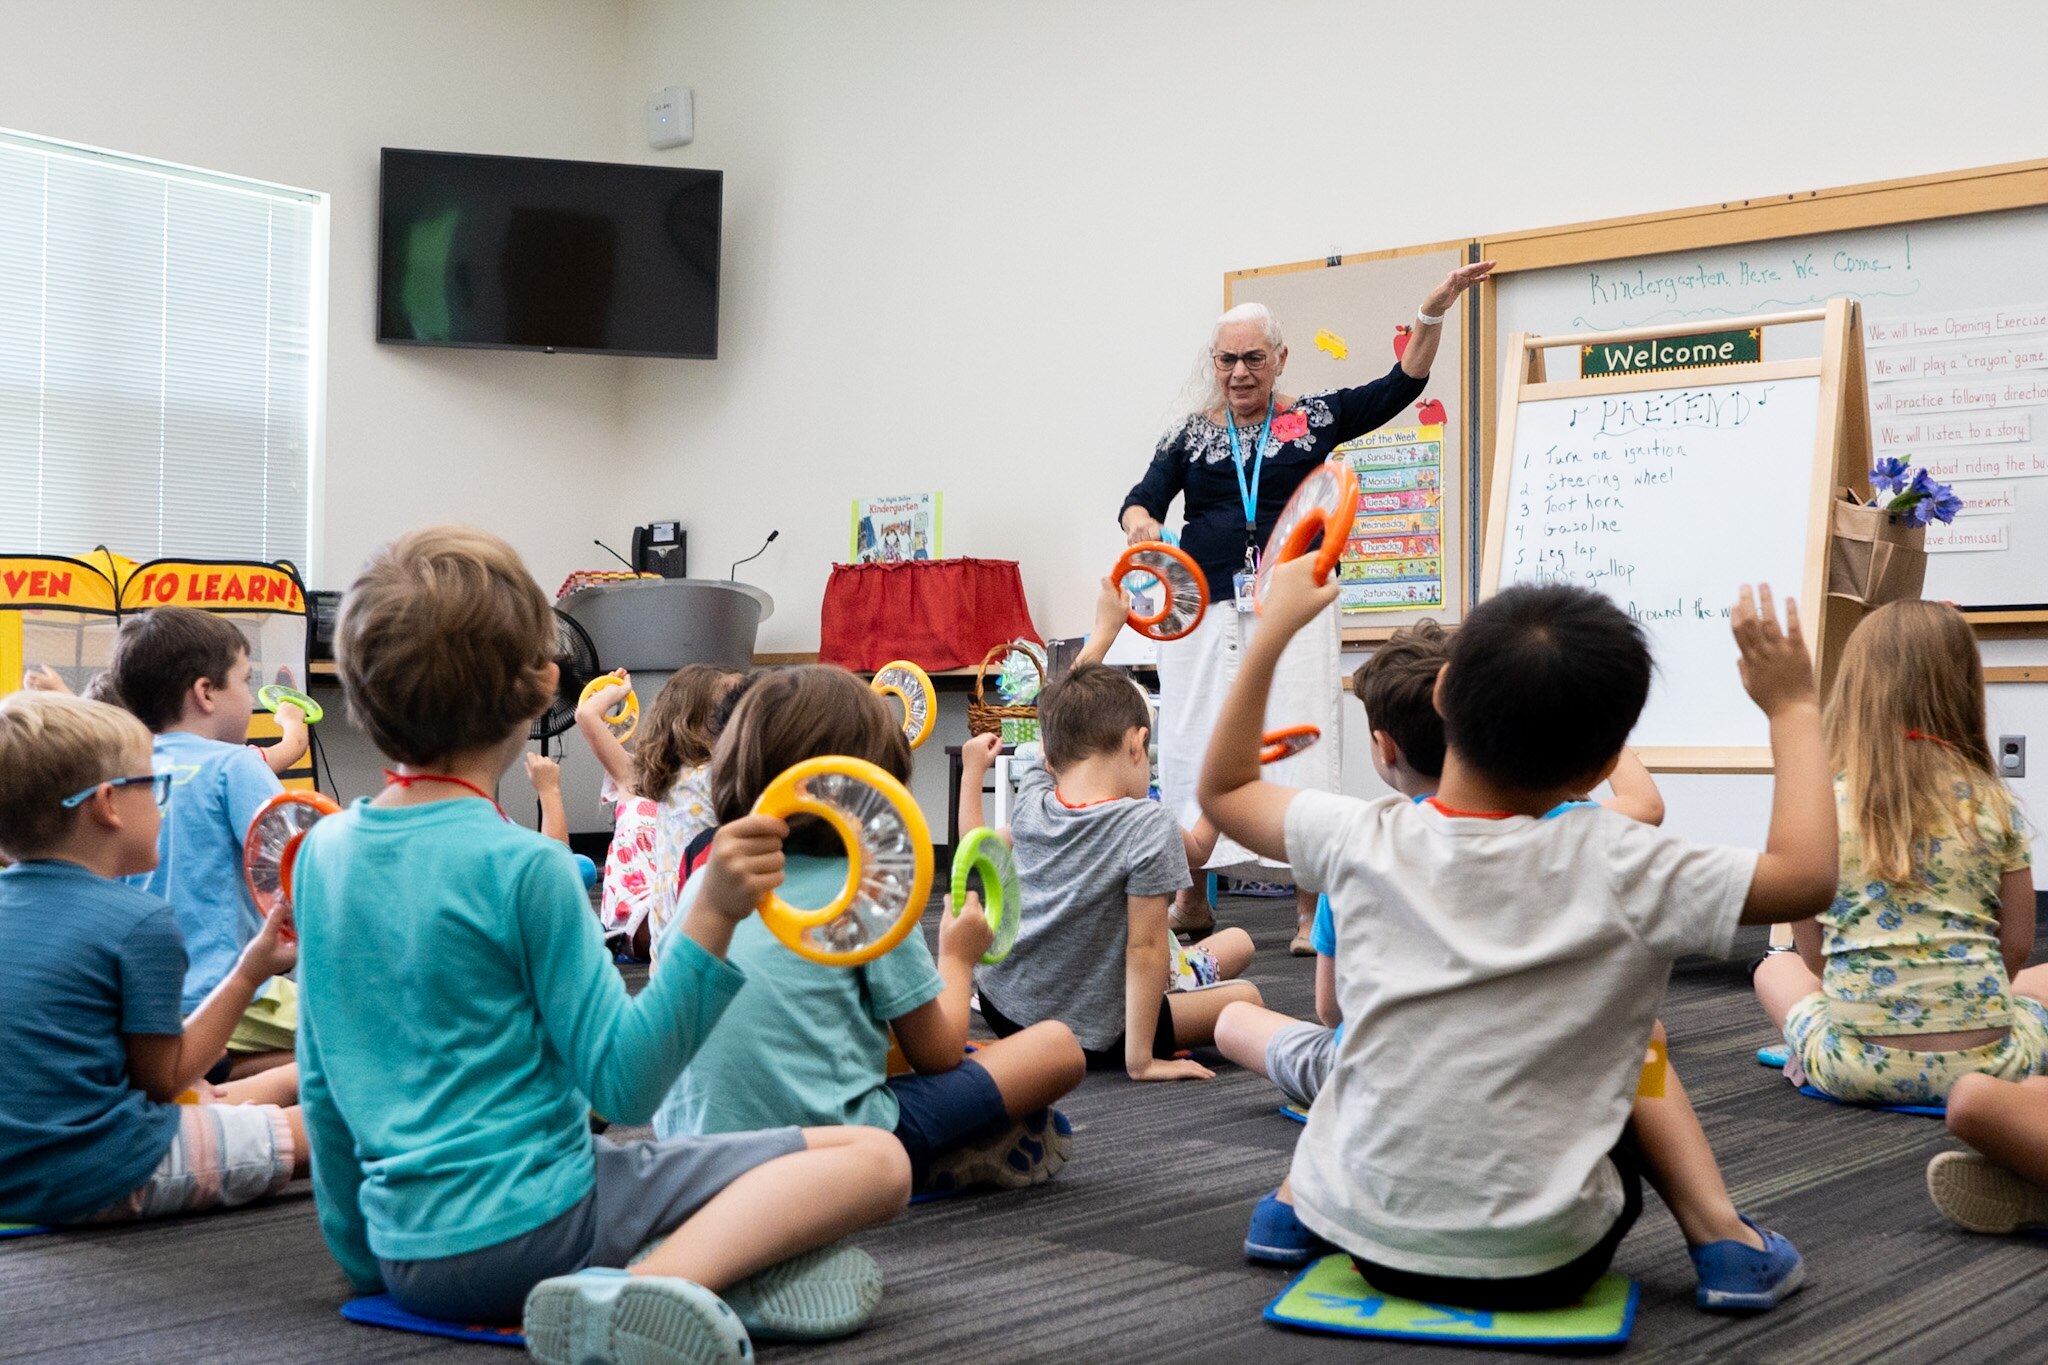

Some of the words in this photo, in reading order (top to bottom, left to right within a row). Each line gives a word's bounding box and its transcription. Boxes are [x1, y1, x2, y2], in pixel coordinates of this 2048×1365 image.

[1590, 264, 1728, 305] Kindergarten
[1739, 261, 1781, 285] Here
[1793, 253, 1818, 280] We
[1869, 325, 1886, 341] We
[1891, 323, 1908, 339] will
[1914, 322, 1939, 336] have
[1945, 318, 1991, 337] Opening
[1604, 341, 1735, 371] Welcome
[1875, 359, 1892, 374] We
[1900, 357, 1916, 373] will
[1923, 356, 1946, 376] play
[1950, 361, 1958, 369] a
[1601, 391, 1750, 431] PRETEND
[1876, 395, 1892, 410] will
[1895, 395, 1944, 413] practice
[1952, 388, 1997, 407] following
[1366, 435, 1377, 445] of
[1378, 435, 1393, 444] the
[1395, 431, 1417, 441] Week
[1881, 428, 1900, 444] We
[1906, 426, 1921, 442] will
[1927, 425, 1962, 440] listen
[1969, 423, 1981, 438] to
[1367, 453, 1396, 463] Sunday
[1546, 445, 1583, 465] Turn
[1593, 448, 1610, 461] on
[1624, 439, 1688, 464] ignition
[1930, 459, 1958, 475] about
[1966, 457, 2000, 476] riding
[2006, 455, 2025, 470] the
[2033, 454, 2048, 469] bu
[1368, 477, 1400, 488] Monday
[1546, 473, 1621, 491] Steering
[1634, 466, 1674, 485] wheel
[869, 502, 918, 515] Kindergarten
[1366, 498, 1399, 508] Tuesday
[1521, 503, 1530, 517] 3
[1544, 495, 1577, 515] Toot
[1586, 493, 1624, 509] horn
[1360, 520, 1406, 530] Wednesday
[1515, 524, 1524, 541] 4
[1544, 514, 1623, 536] Gasoline
[1363, 541, 1402, 553] Thursday
[1926, 535, 1944, 546] ave
[1539, 548, 1565, 571] Leg
[1574, 541, 1597, 562] tap
[1367, 564, 1393, 575] Friday
[1586, 558, 1636, 588] gallop
[0, 570, 72, 599] VEN
[142, 571, 180, 603] TO
[187, 572, 298, 609] LEARN!
[1363, 589, 1402, 600] Saturday
[1628, 597, 1682, 624] Around
[1693, 597, 1716, 620] the
